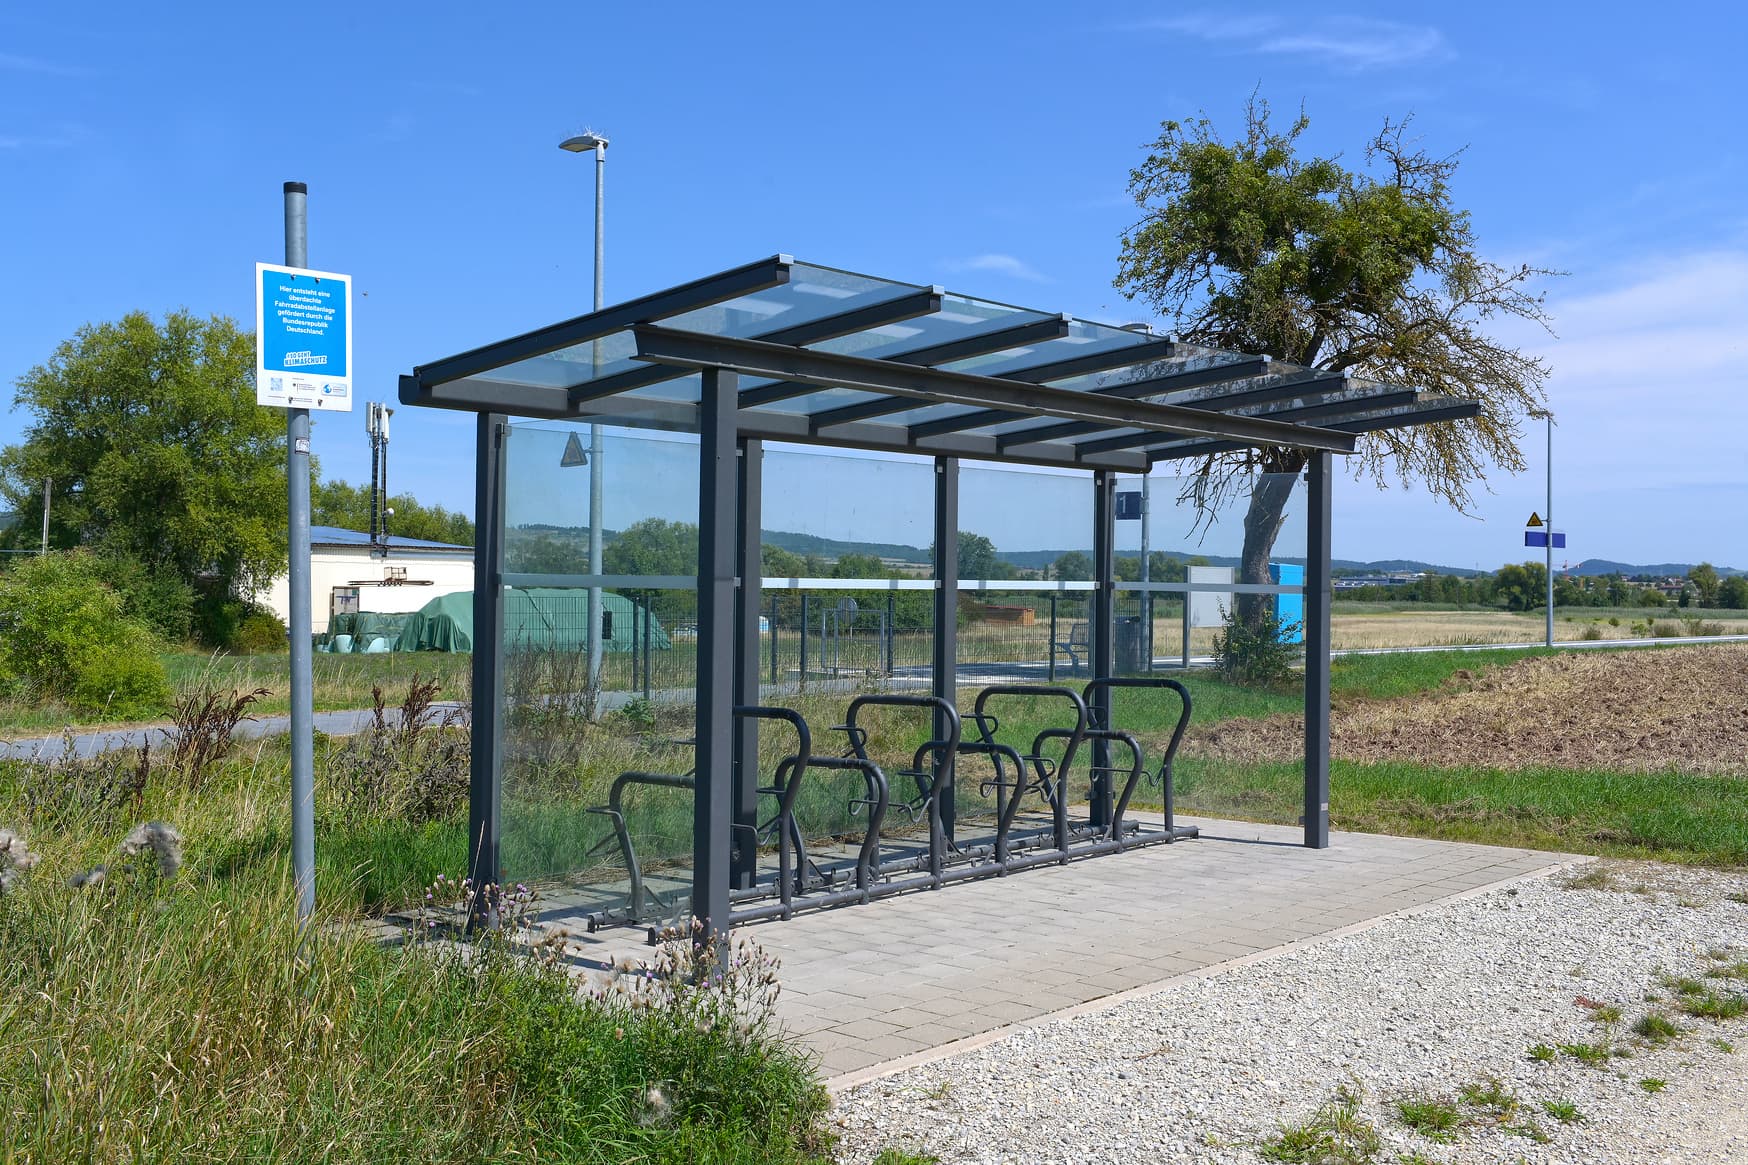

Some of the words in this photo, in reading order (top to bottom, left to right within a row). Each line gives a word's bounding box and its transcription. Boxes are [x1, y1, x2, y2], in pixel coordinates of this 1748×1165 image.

[280, 285, 292, 293] Hier
[293, 287, 317, 296] entsteht
[274, 300, 336, 315] Fahrradabstellanlage
[277, 309, 305, 318] gefördert
[305, 311, 323, 320] durch
[323, 313, 333, 321] die
[282, 317, 329, 328] Bundesrepublik
[286, 325, 325, 336] Deutschland.
[284, 356, 326, 366] KLIMASCHUTZ
[1119, 495, 1126, 513] 1
